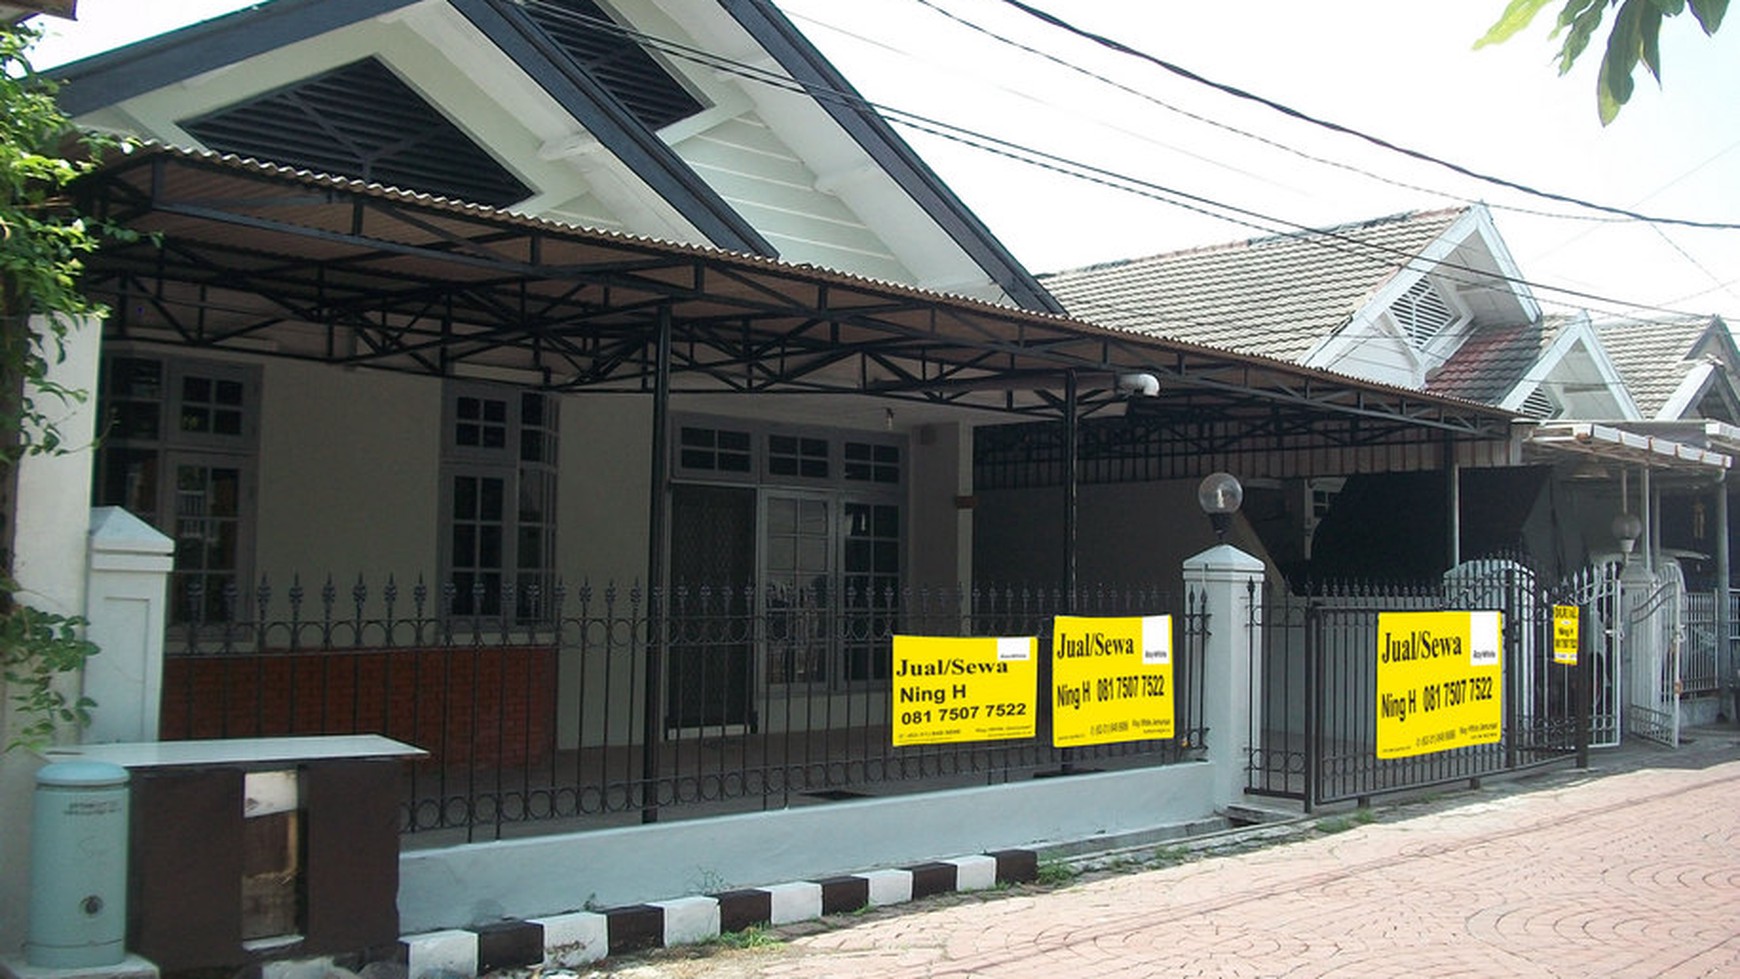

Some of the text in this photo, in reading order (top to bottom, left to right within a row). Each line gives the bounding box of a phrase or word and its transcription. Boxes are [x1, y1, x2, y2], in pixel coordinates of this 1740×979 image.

[1057, 632, 1134, 660] Jual/Sewa
[1382, 630, 1462, 664] Jual/Sewa
[896, 658, 1008, 677] Jual/Sewa
[900, 684, 966, 704] Ning H
[1057, 674, 1165, 710] Ning H 081 7507 7522
[1381, 676, 1493, 722] Ning H 081 7507 7522
[901, 703, 1027, 725] 081 7507 7522
